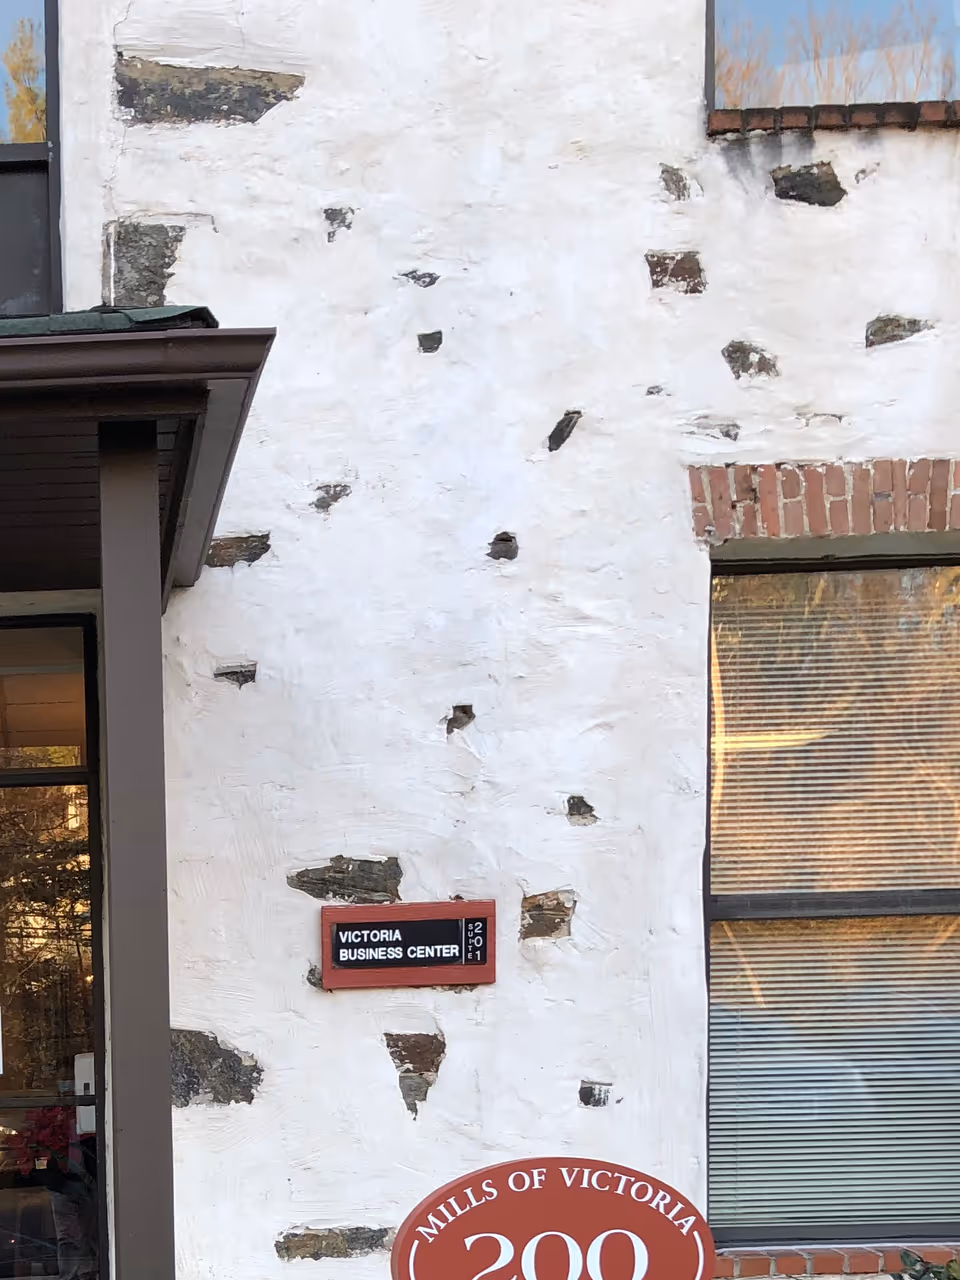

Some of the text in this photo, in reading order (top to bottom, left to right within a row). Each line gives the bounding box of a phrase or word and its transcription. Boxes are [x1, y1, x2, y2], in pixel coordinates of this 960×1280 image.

[339, 929, 402, 943] VICTORIA
[474, 922, 483, 961] 201
[339, 944, 460, 961] BUSINESS CENTER
[415, 1167, 698, 1244] MILLS OF VICTORIA
